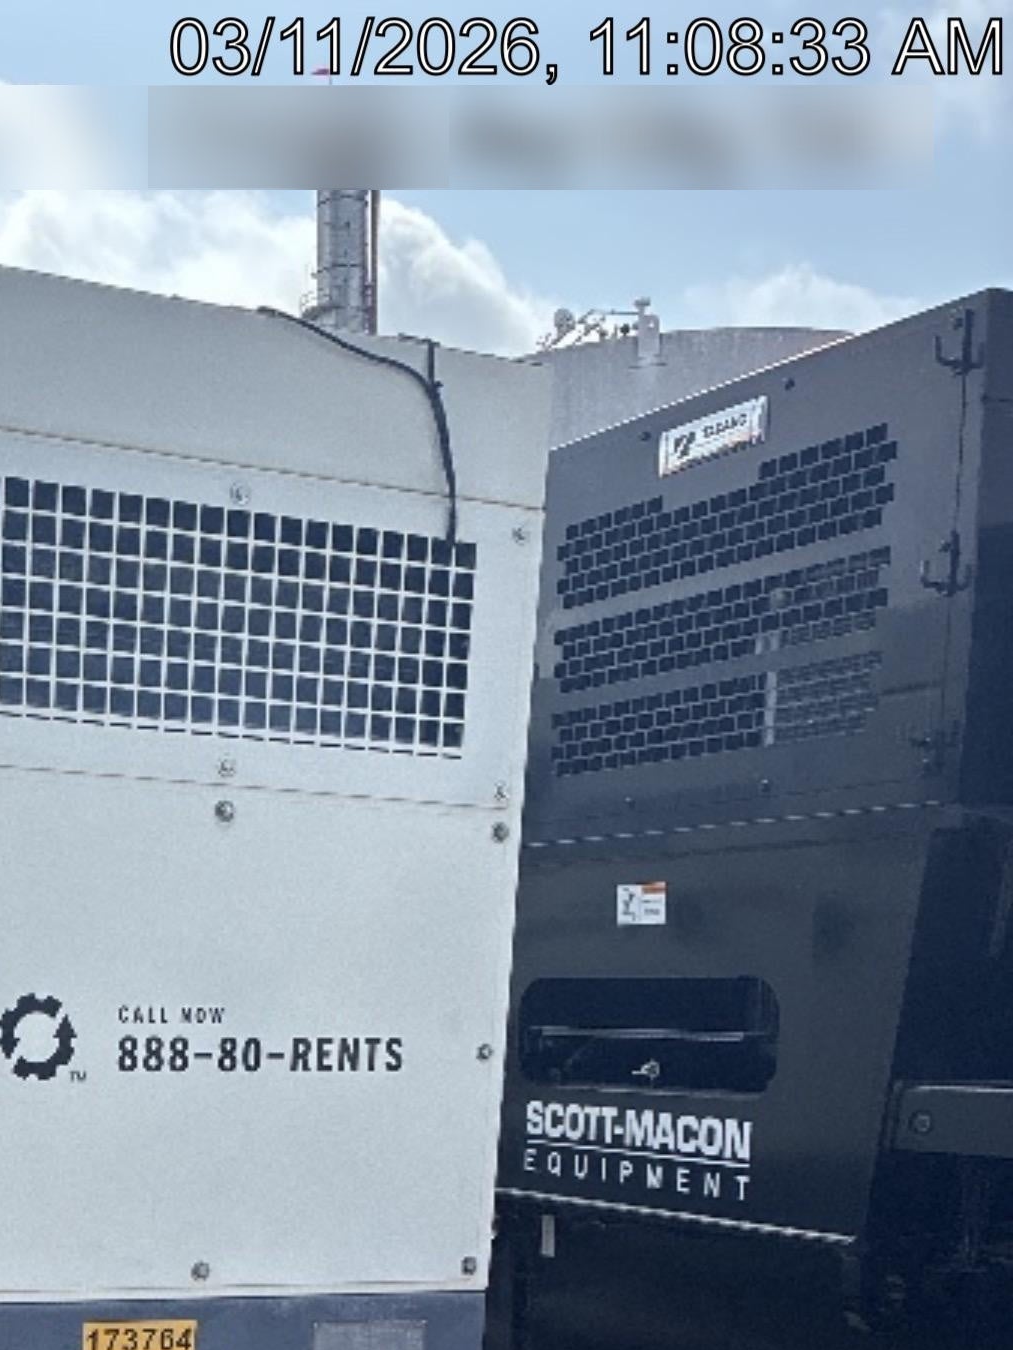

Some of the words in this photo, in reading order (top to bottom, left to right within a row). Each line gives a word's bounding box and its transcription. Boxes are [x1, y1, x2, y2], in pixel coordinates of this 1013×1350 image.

[117, 1005, 168, 1025] CALL
[180, 1007, 226, 1025] NOW
[117, 1035, 404, 1073] 888-80-RENTS
[526, 1101, 752, 1161] SCOTT-MACON
[523, 1148, 750, 1201] EQUIPMENT
